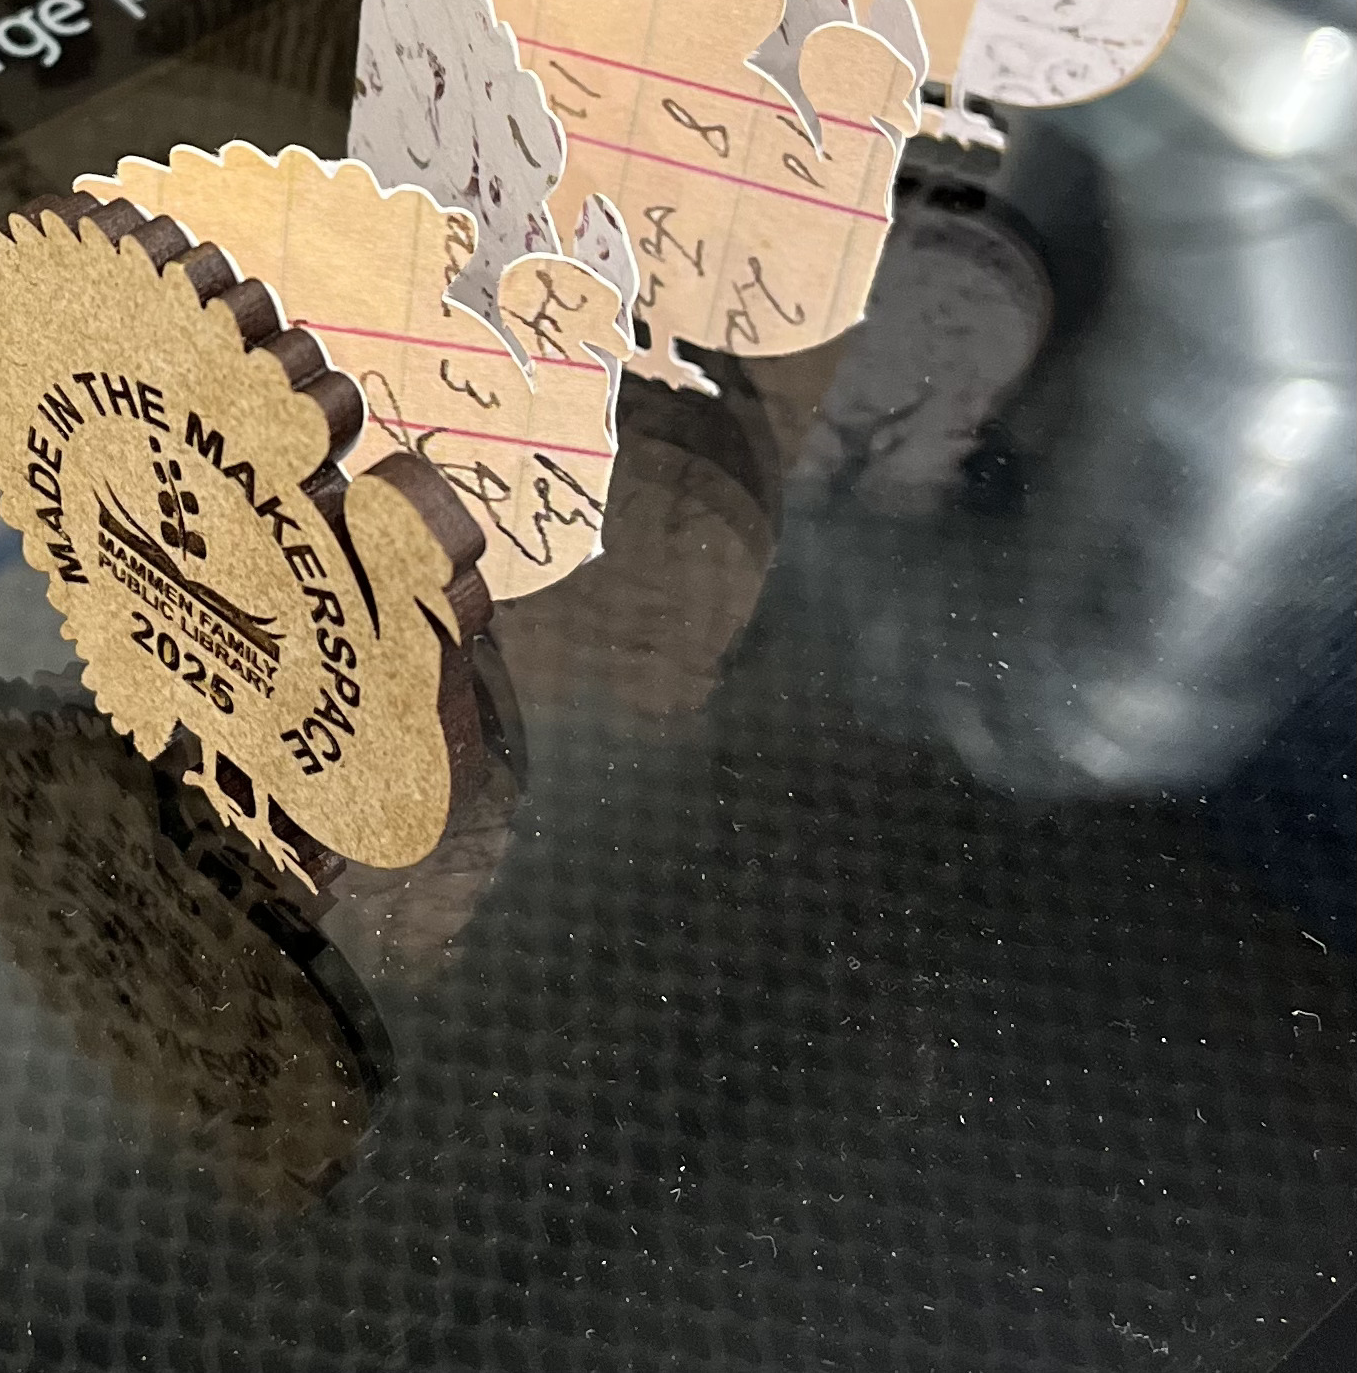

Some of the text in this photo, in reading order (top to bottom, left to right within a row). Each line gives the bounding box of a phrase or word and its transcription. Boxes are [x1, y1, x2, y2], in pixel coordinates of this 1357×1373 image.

[37, 382, 85, 441] IN
[71, 372, 170, 433] THE
[25, 425, 90, 586] MADE
[97, 530, 278, 679] MAMMEN FAMILY
[97, 550, 276, 700] PUBLIC LIBRARY
[130, 610, 235, 716] 2025
[184, 410, 362, 776] MAKERSPACE
